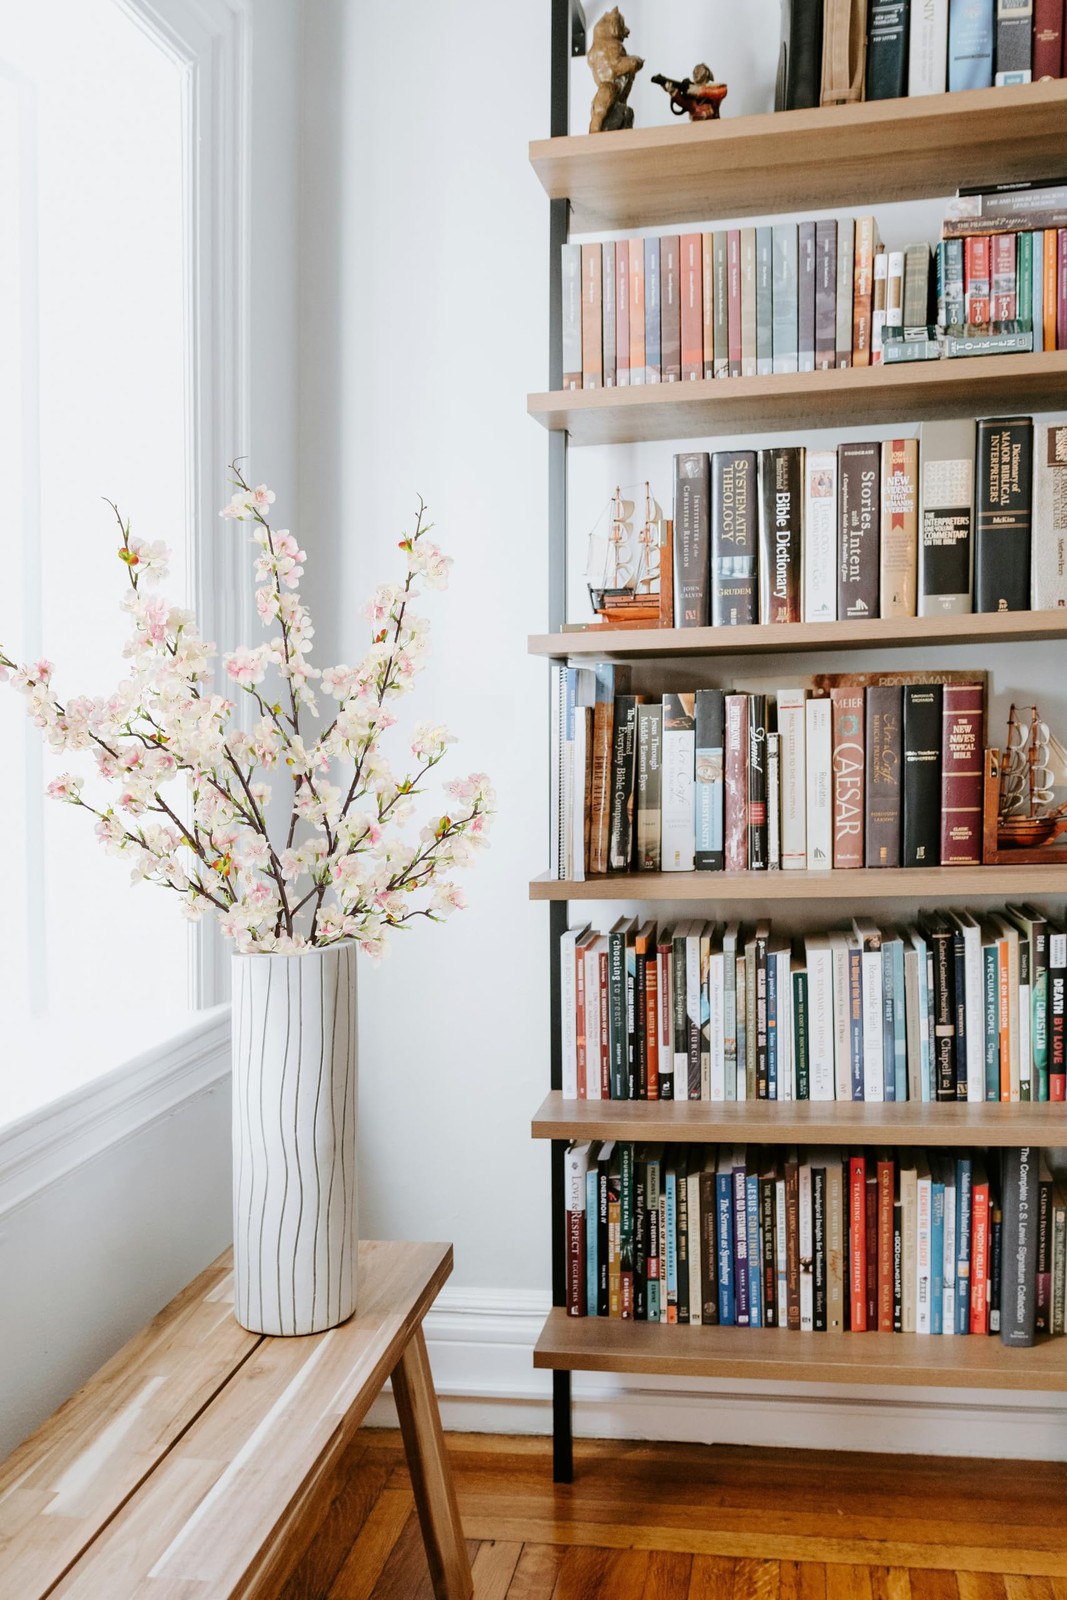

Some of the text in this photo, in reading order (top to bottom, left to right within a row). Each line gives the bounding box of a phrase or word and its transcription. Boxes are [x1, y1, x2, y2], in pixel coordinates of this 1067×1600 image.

[956, 338, 1016, 350] TOLKIEN
[888, 476, 910, 486] NEW
[990, 434, 999, 503] INTERPRETERS
[1000, 431, 1010, 506] MAJOR BIBLICAL
[1011, 444, 1022, 492] Dictionary of
[722, 465, 734, 542] THEOLOGY
[735, 460, 748, 545] SYSTEMATIC
[851, 511, 860, 526] with
[861, 471, 876, 530] Stories
[774, 492, 790, 599] Bible Dictionary
[850, 530, 863, 582] Intent
[924, 530, 968, 539] COMMENTARY
[833, 698, 863, 709] MEIER
[626, 722, 634, 754] Illustrated
[650, 716, 659, 770] Jesus Through
[731, 705, 740, 750] DEUTERONOMY
[750, 726, 764, 773] Daniel
[953, 725, 972, 733] NEW
[594, 756, 608, 780] BIBLE
[639, 716, 648, 791] Middle Eastern Eyes
[789, 758, 796, 766] TO
[594, 784, 606, 812] ATLAS
[614, 726, 627, 841] Everyday Bible Companion
[833, 743, 864, 841] CAESAR
[613, 940, 622, 1027] choosing to preach
[726, 952, 734, 990] Preaching
[940, 940, 948, 1023] Christ-Centered Preaching
[1002, 985, 1007, 995] ON
[1036, 966, 1046, 1049] ALMOST CHRISTIAN
[1054, 979, 1063, 1064] DEATH BY LOVE
[940, 1038, 950, 1075] Chapell
[986, 1043, 995, 1064] Clapp
[571, 1176, 581, 1201] LOVE
[748, 1184, 756, 1212] JESUS
[571, 1211, 581, 1254] RESPECT
[660, 1231, 666, 1239] OF
[736, 1173, 747, 1259] CRACKING OLD TESTAMENT CODES
[766, 1232, 772, 1242] BE
[1017, 1147, 1029, 1323] The Complete C. S. Lewis Signature Collection
[720, 1199, 730, 1285] The Sermon as Symphony
